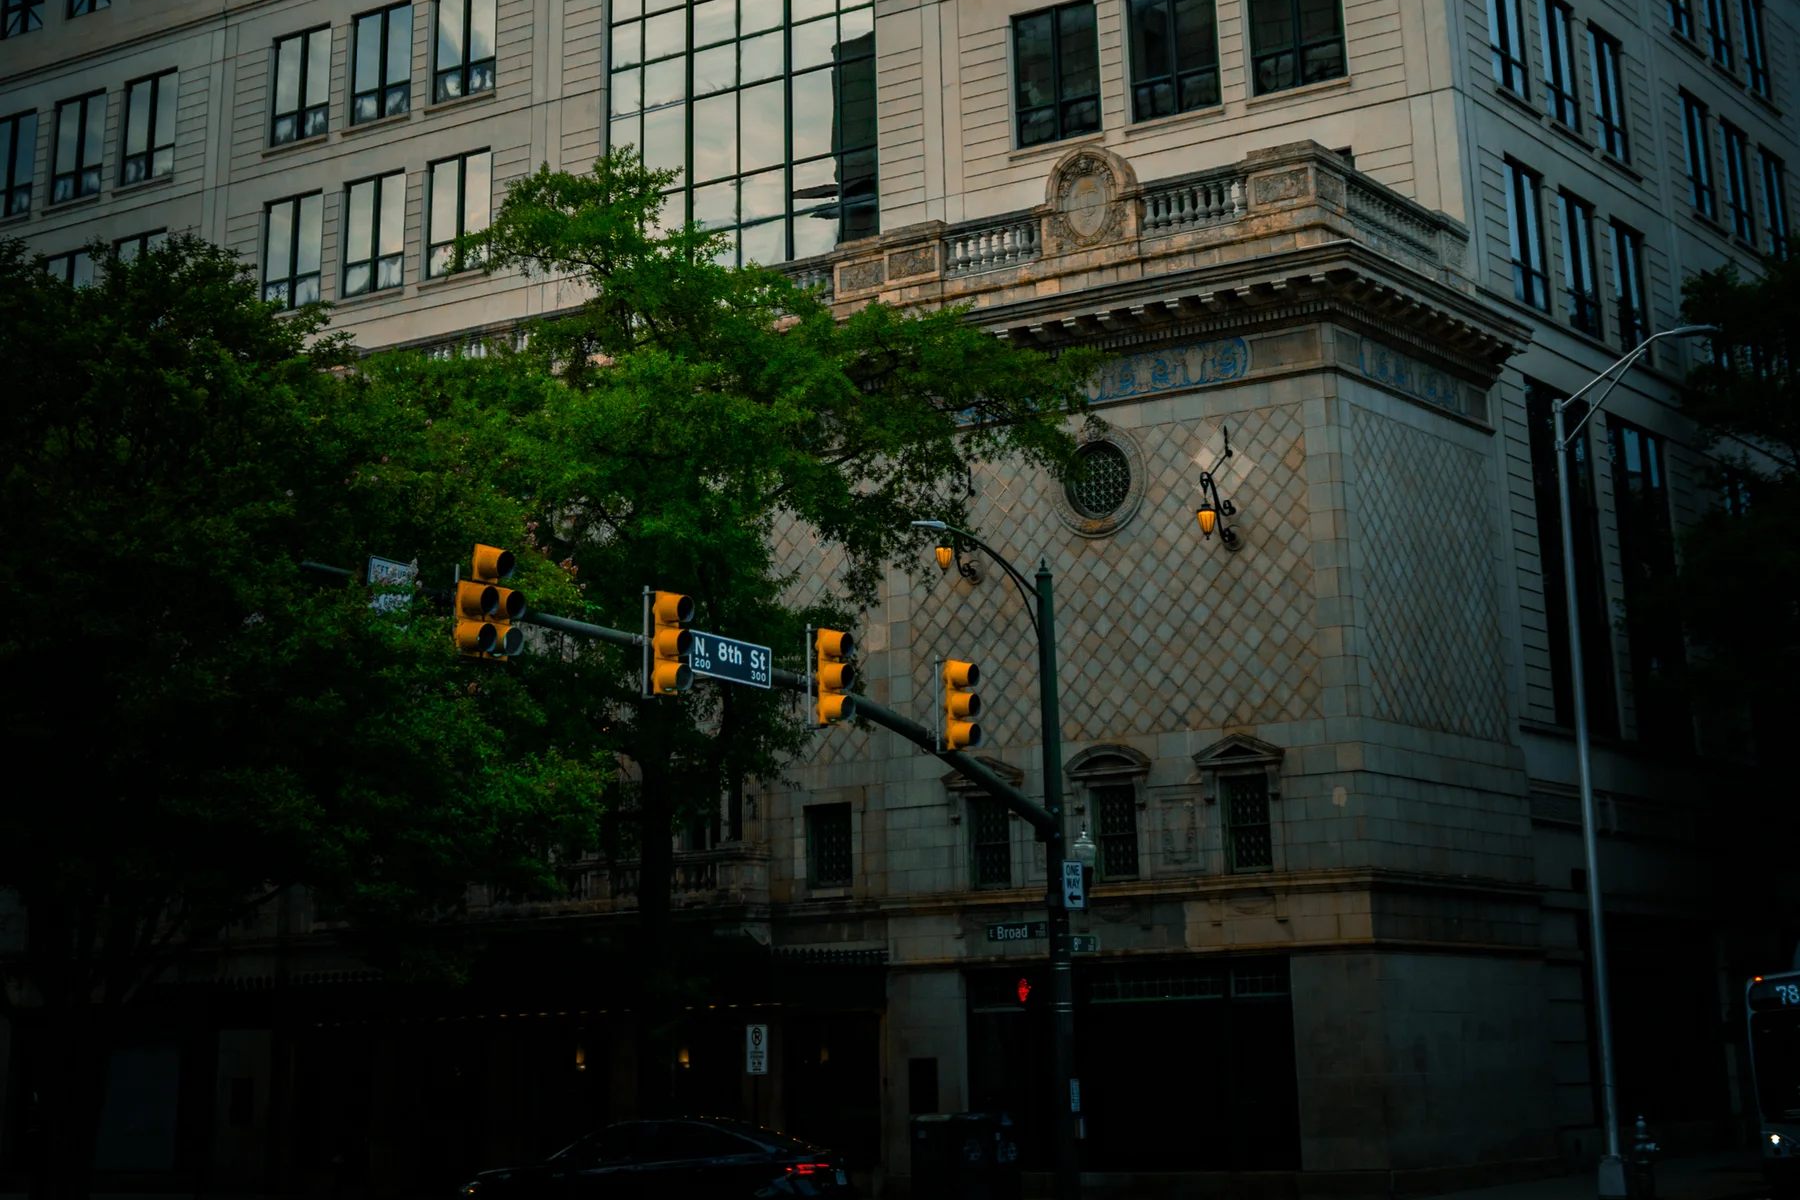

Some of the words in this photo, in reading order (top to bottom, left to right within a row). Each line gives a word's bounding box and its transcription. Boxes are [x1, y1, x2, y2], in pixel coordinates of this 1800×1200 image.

[694, 636, 709, 657] N.
[718, 642, 742, 665] 8th
[750, 649, 766, 670] St
[694, 657, 711, 670] 200
[751, 670, 767, 682] 300
[1066, 864, 1080, 876] ONE
[1066, 878, 1080, 889] WAY
[989, 929, 995, 938] E
[997, 924, 1028, 940] Broad
[1775, 984, 1800, 1005] 78
